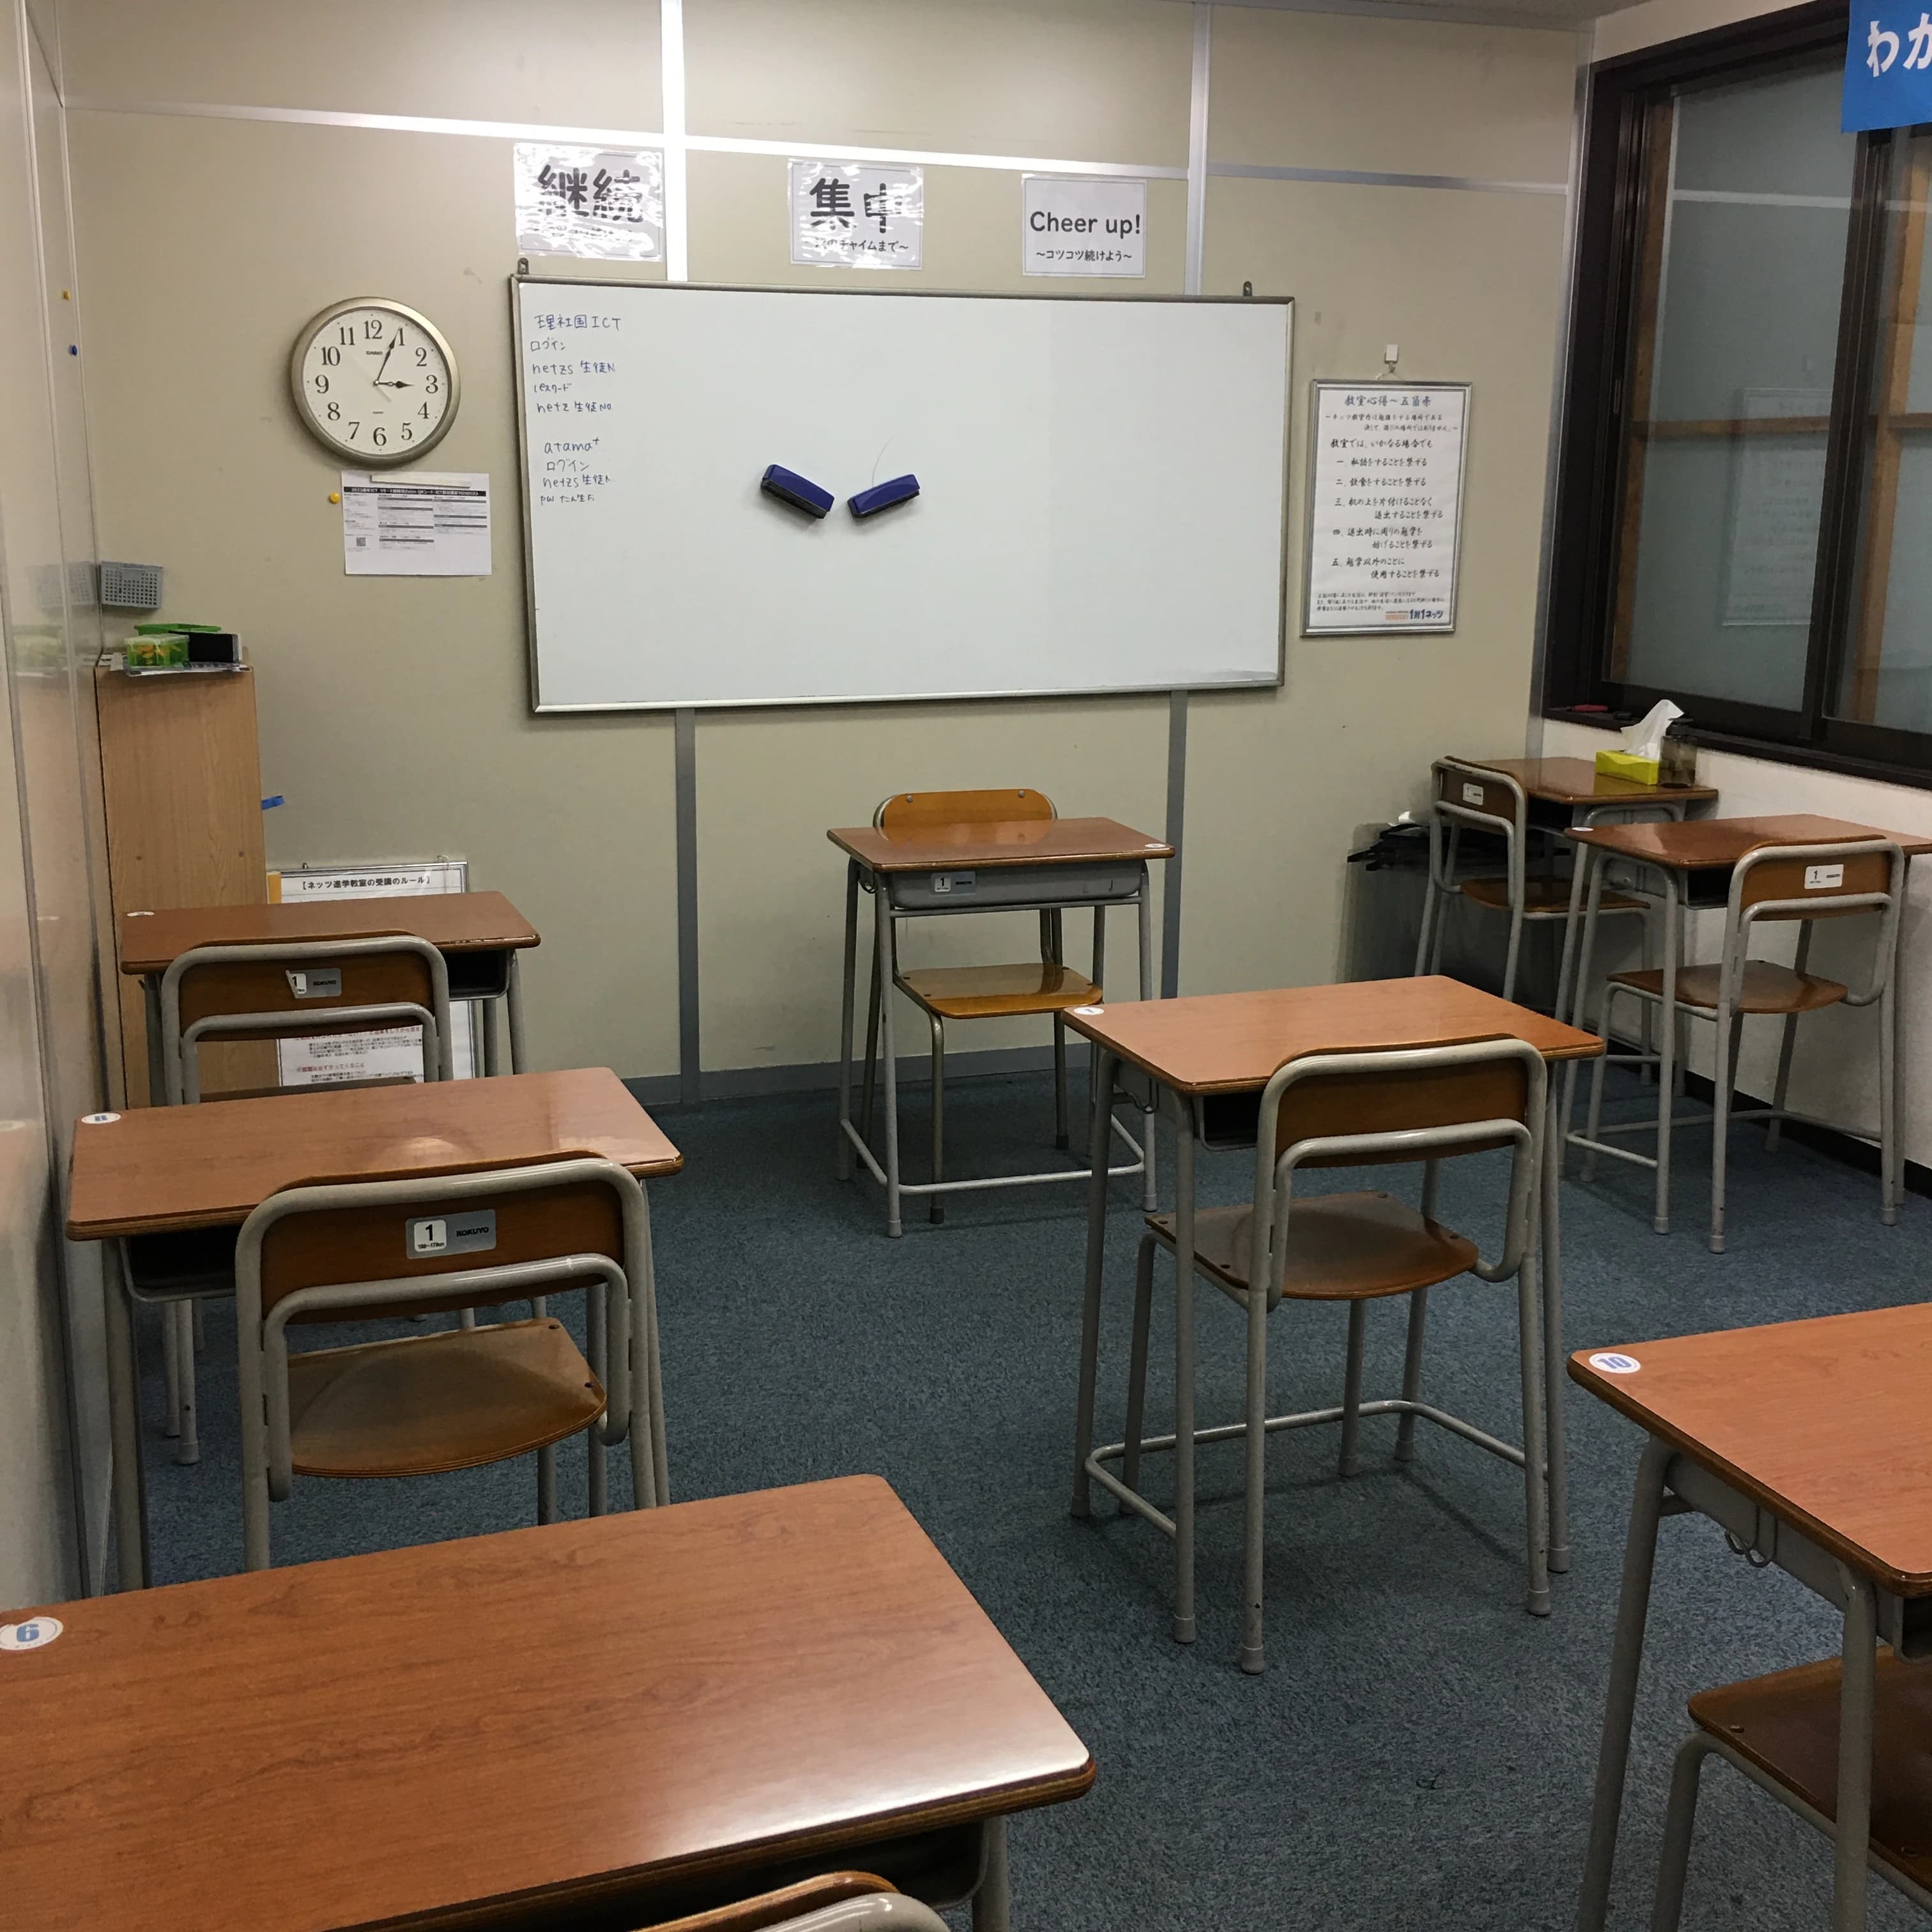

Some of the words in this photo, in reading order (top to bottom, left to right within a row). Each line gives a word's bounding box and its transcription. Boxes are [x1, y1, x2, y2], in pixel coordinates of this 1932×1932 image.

[809, 178, 902, 233] 集中
[1030, 211, 1098, 233] Cheer
[1106, 214, 1140, 239] up!
[339, 326, 355, 346] 11
[364, 319, 383, 339] 12
[398, 327, 406, 346] 1
[530, 337, 565, 351] ログイン
[321, 346, 341, 366] 10
[415, 347, 427, 367] 2
[315, 374, 329, 394] 9
[425, 374, 439, 394] 3
[327, 402, 341, 420] 8
[417, 401, 429, 419] 4
[348, 421, 360, 440] 7
[373, 427, 387, 446] 6
[401, 422, 413, 440] 5
[547, 459, 590, 473] ログイン
[940, 877, 944, 887] 1
[292, 976, 297, 987] 1
[425, 1224, 433, 1241] 1
[456, 1226, 489, 1237] KOKUYO
[1597, 1356, 1632, 1369] 10
[17, 1623, 40, 1642] 6
